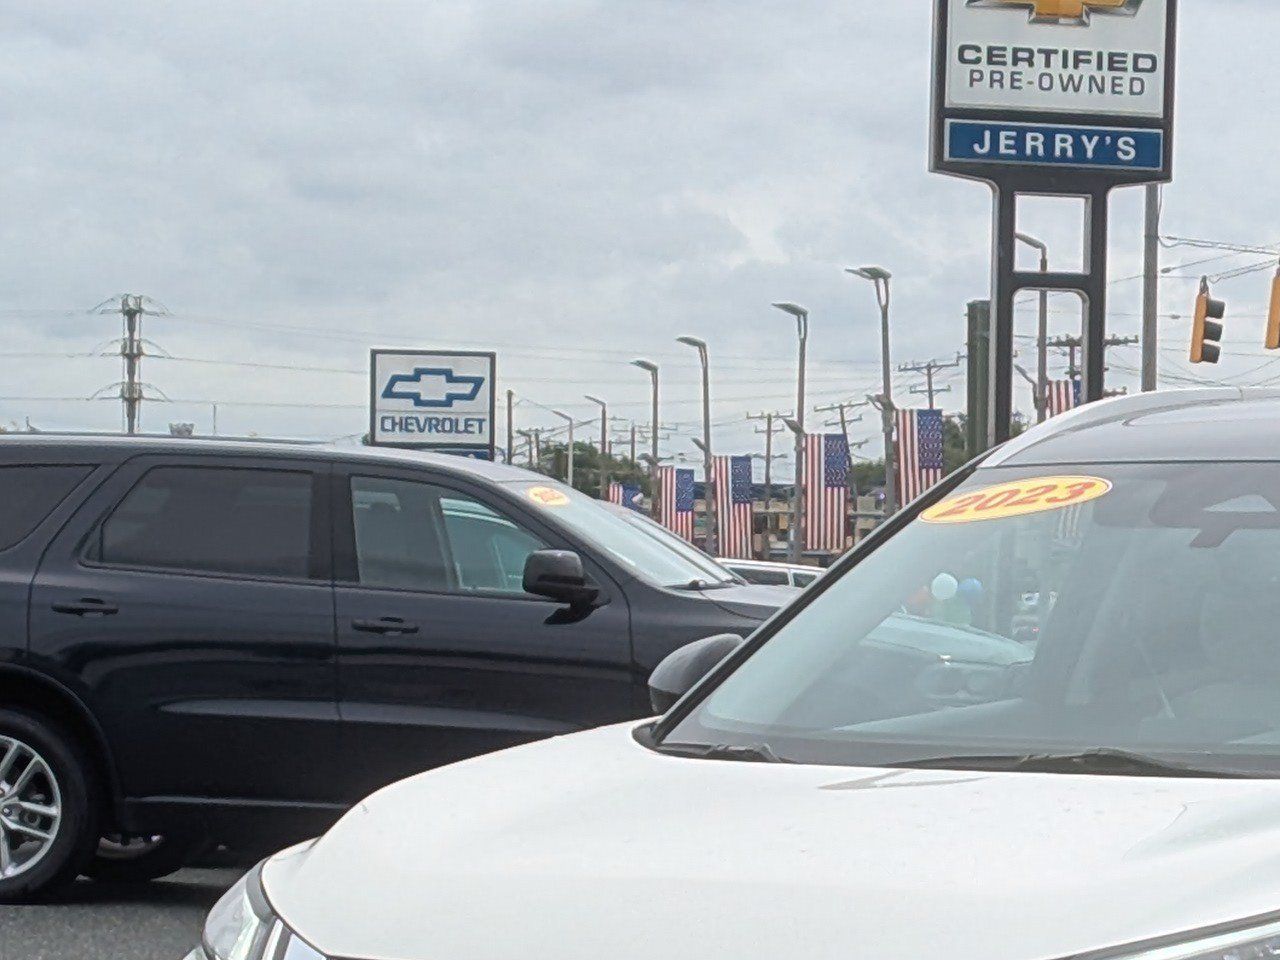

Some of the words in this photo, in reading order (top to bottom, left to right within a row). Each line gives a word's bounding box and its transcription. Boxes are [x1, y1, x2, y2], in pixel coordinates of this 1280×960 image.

[957, 44, 1158, 73] CERTIFIED
[968, 69, 1146, 96] PRE-OWNED
[973, 129, 1137, 160] JERRY'S
[380, 415, 487, 434] CHEVROLET
[934, 481, 1097, 518] 2023
